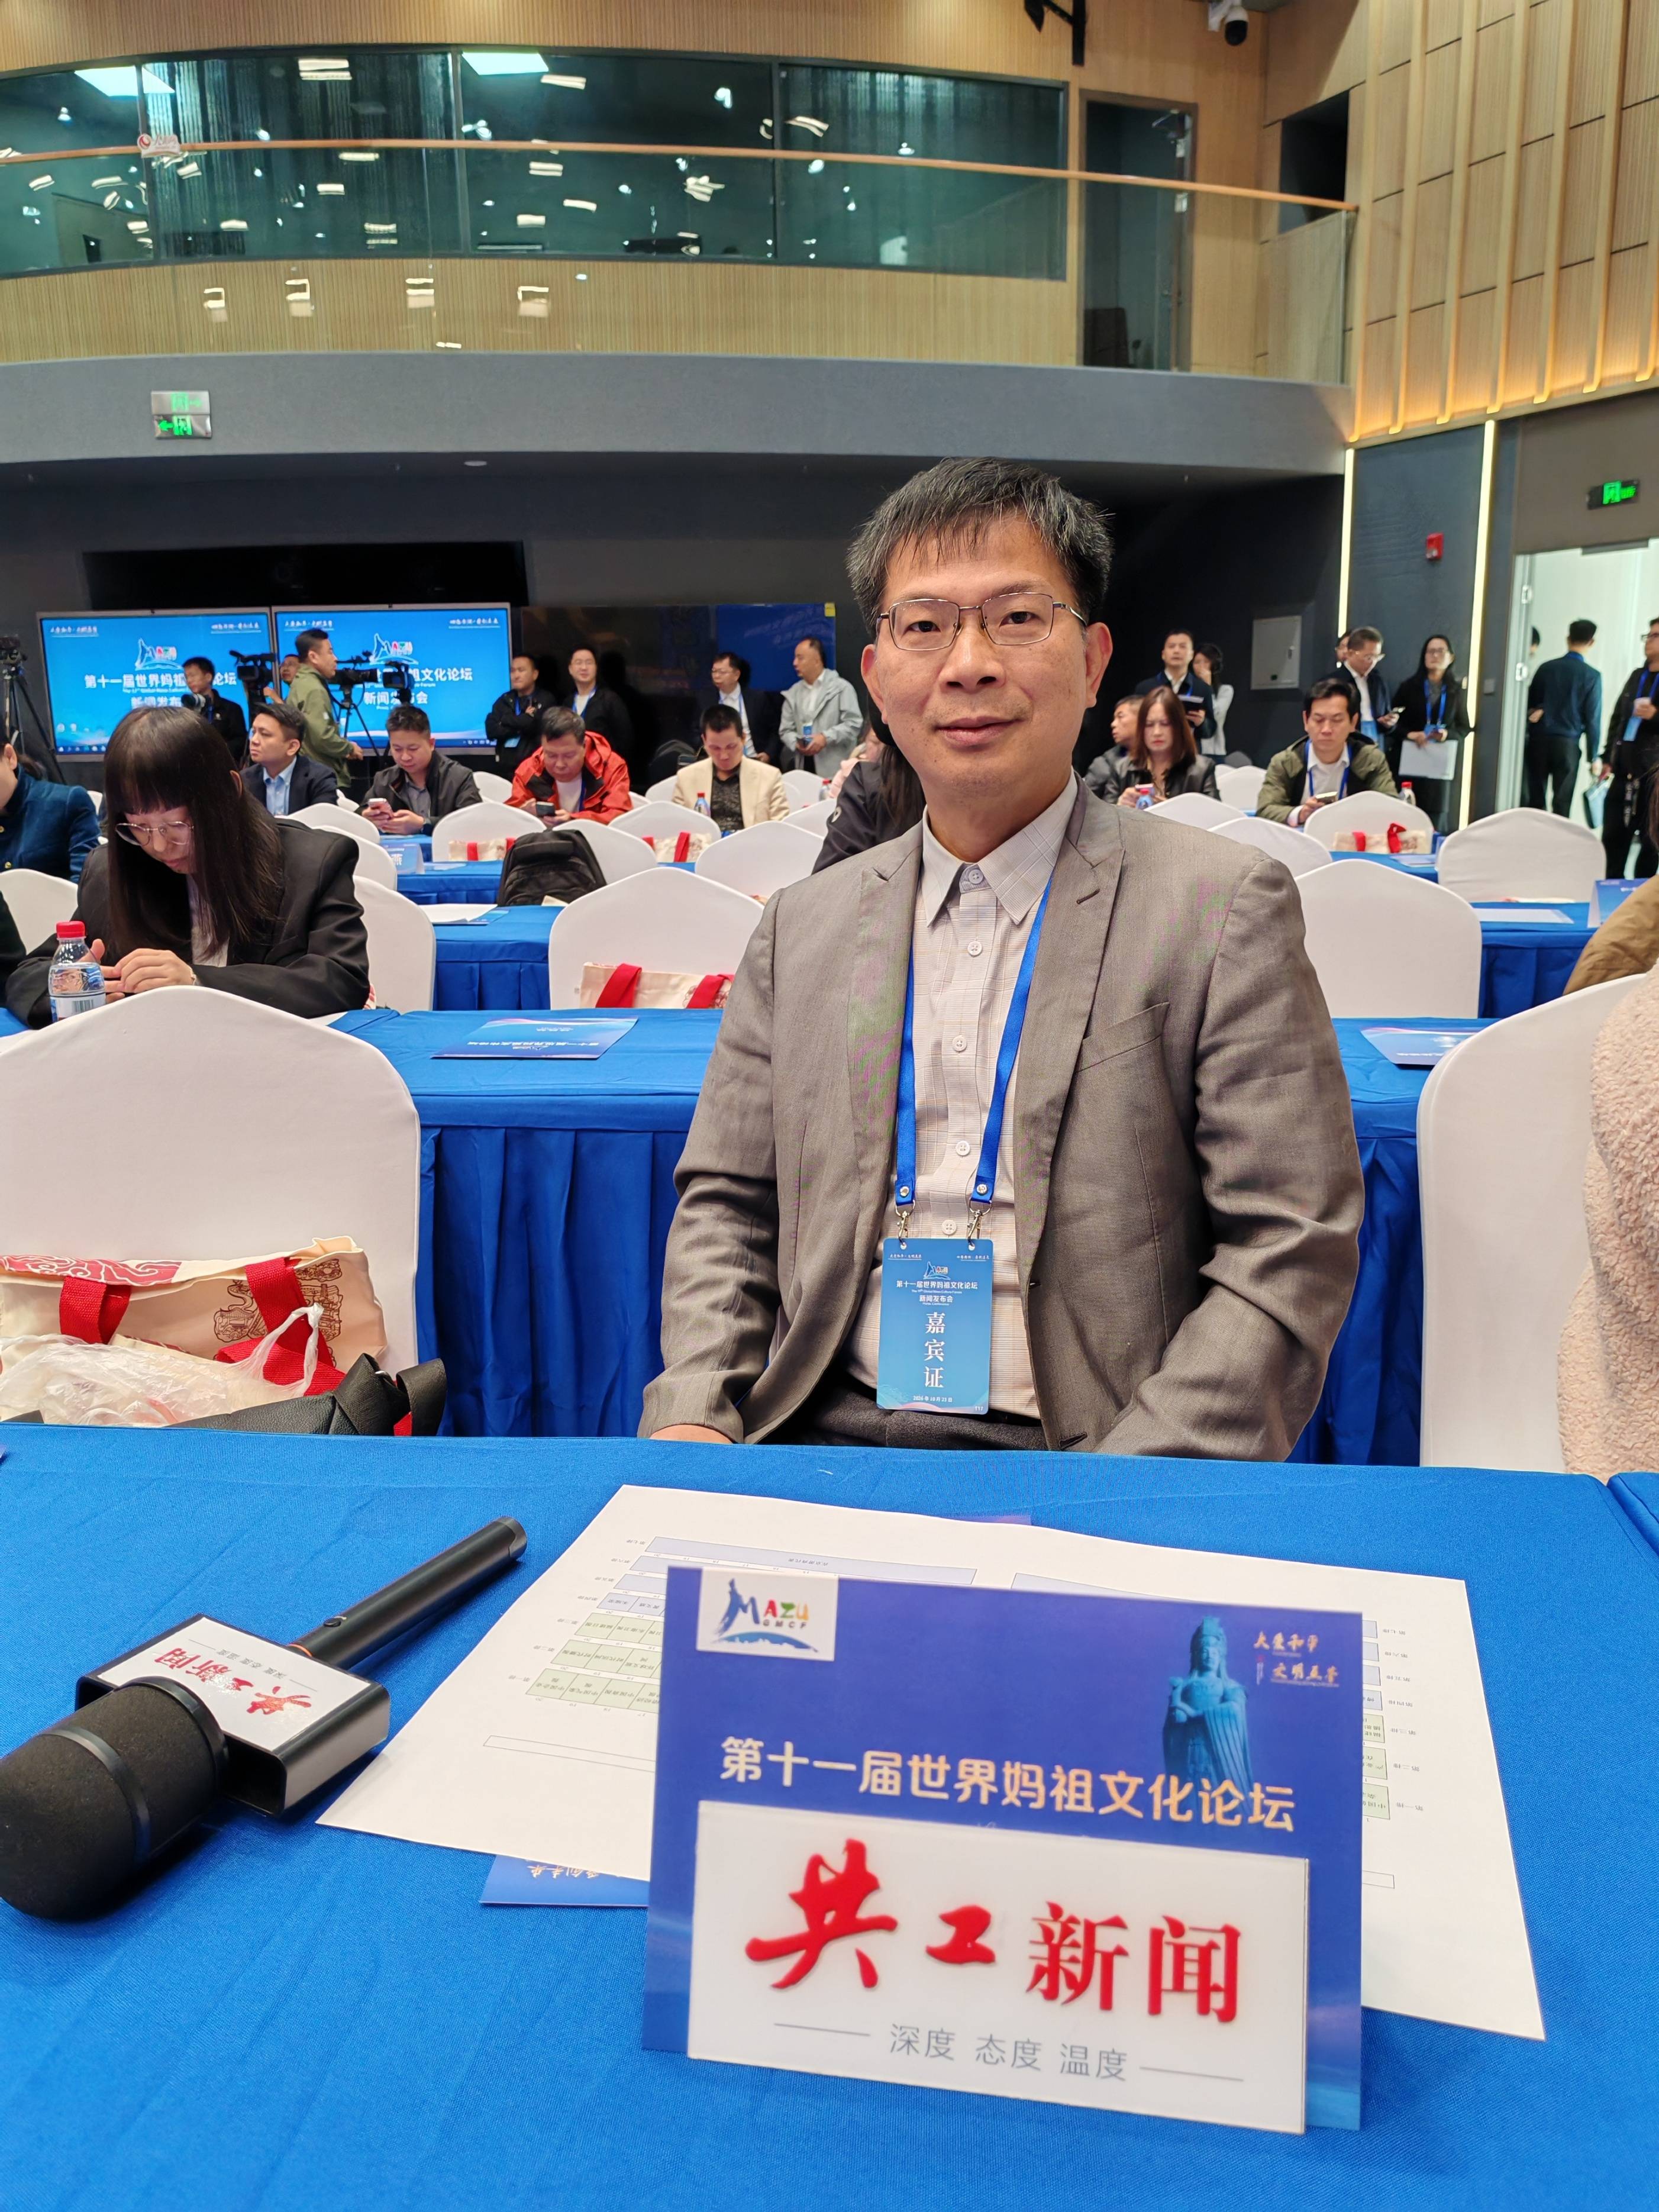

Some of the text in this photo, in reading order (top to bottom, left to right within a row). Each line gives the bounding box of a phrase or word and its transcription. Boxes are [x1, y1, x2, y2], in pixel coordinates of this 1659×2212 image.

[896, 1280, 978, 1289] 第十一届世界妈祖文化论坛
[923, 1311, 946, 1388] 嘉宾证
[715, 1578, 809, 1636] MAZU
[763, 1619, 807, 1629] GMCF
[720, 1736, 1295, 1833] 第十一届世界妈祖文化论坛
[744, 1838, 1241, 2023] 共工新闻
[889, 2023, 1128, 2082] 深度 态度 温度
